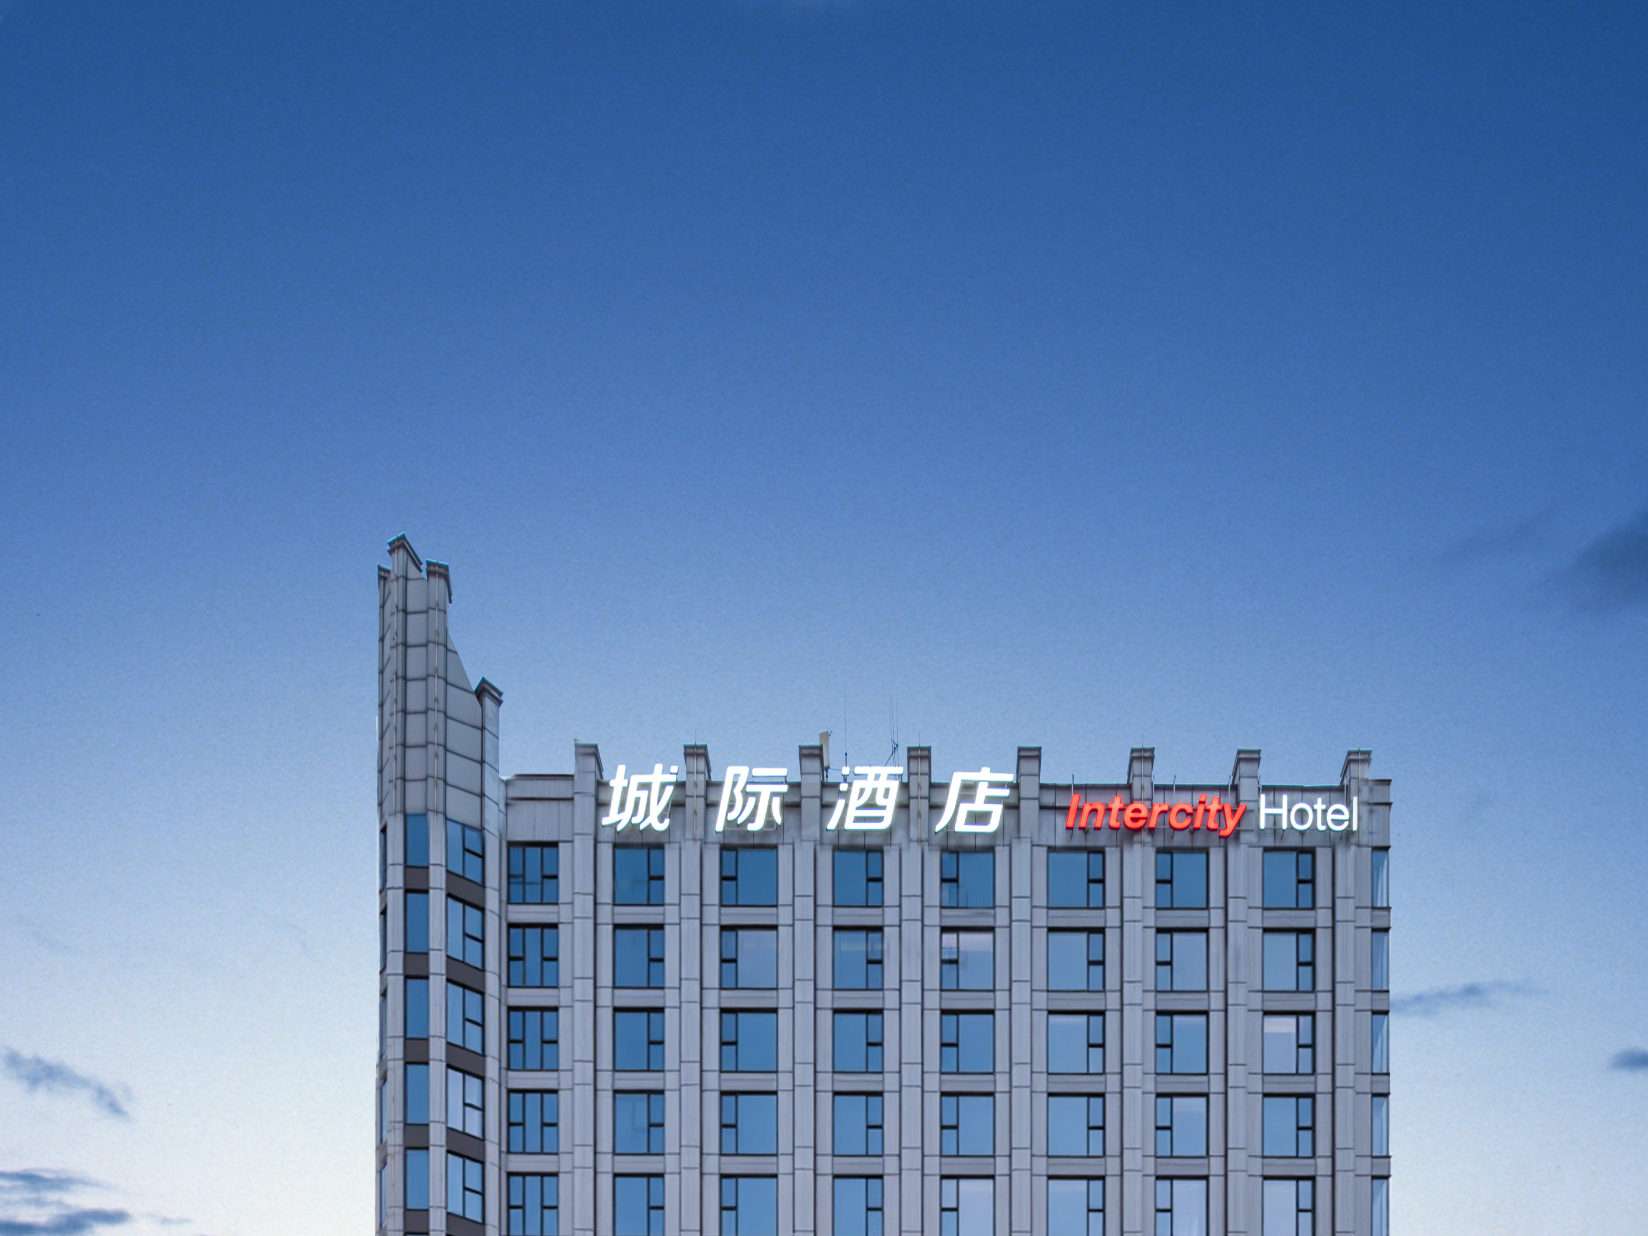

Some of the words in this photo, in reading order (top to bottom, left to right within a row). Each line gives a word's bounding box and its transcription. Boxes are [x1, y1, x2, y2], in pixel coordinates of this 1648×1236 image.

[602, 763, 1014, 833] 城际酒店
[1065, 793, 1248, 838] Intercity
[1259, 793, 1358, 832] Hotel
